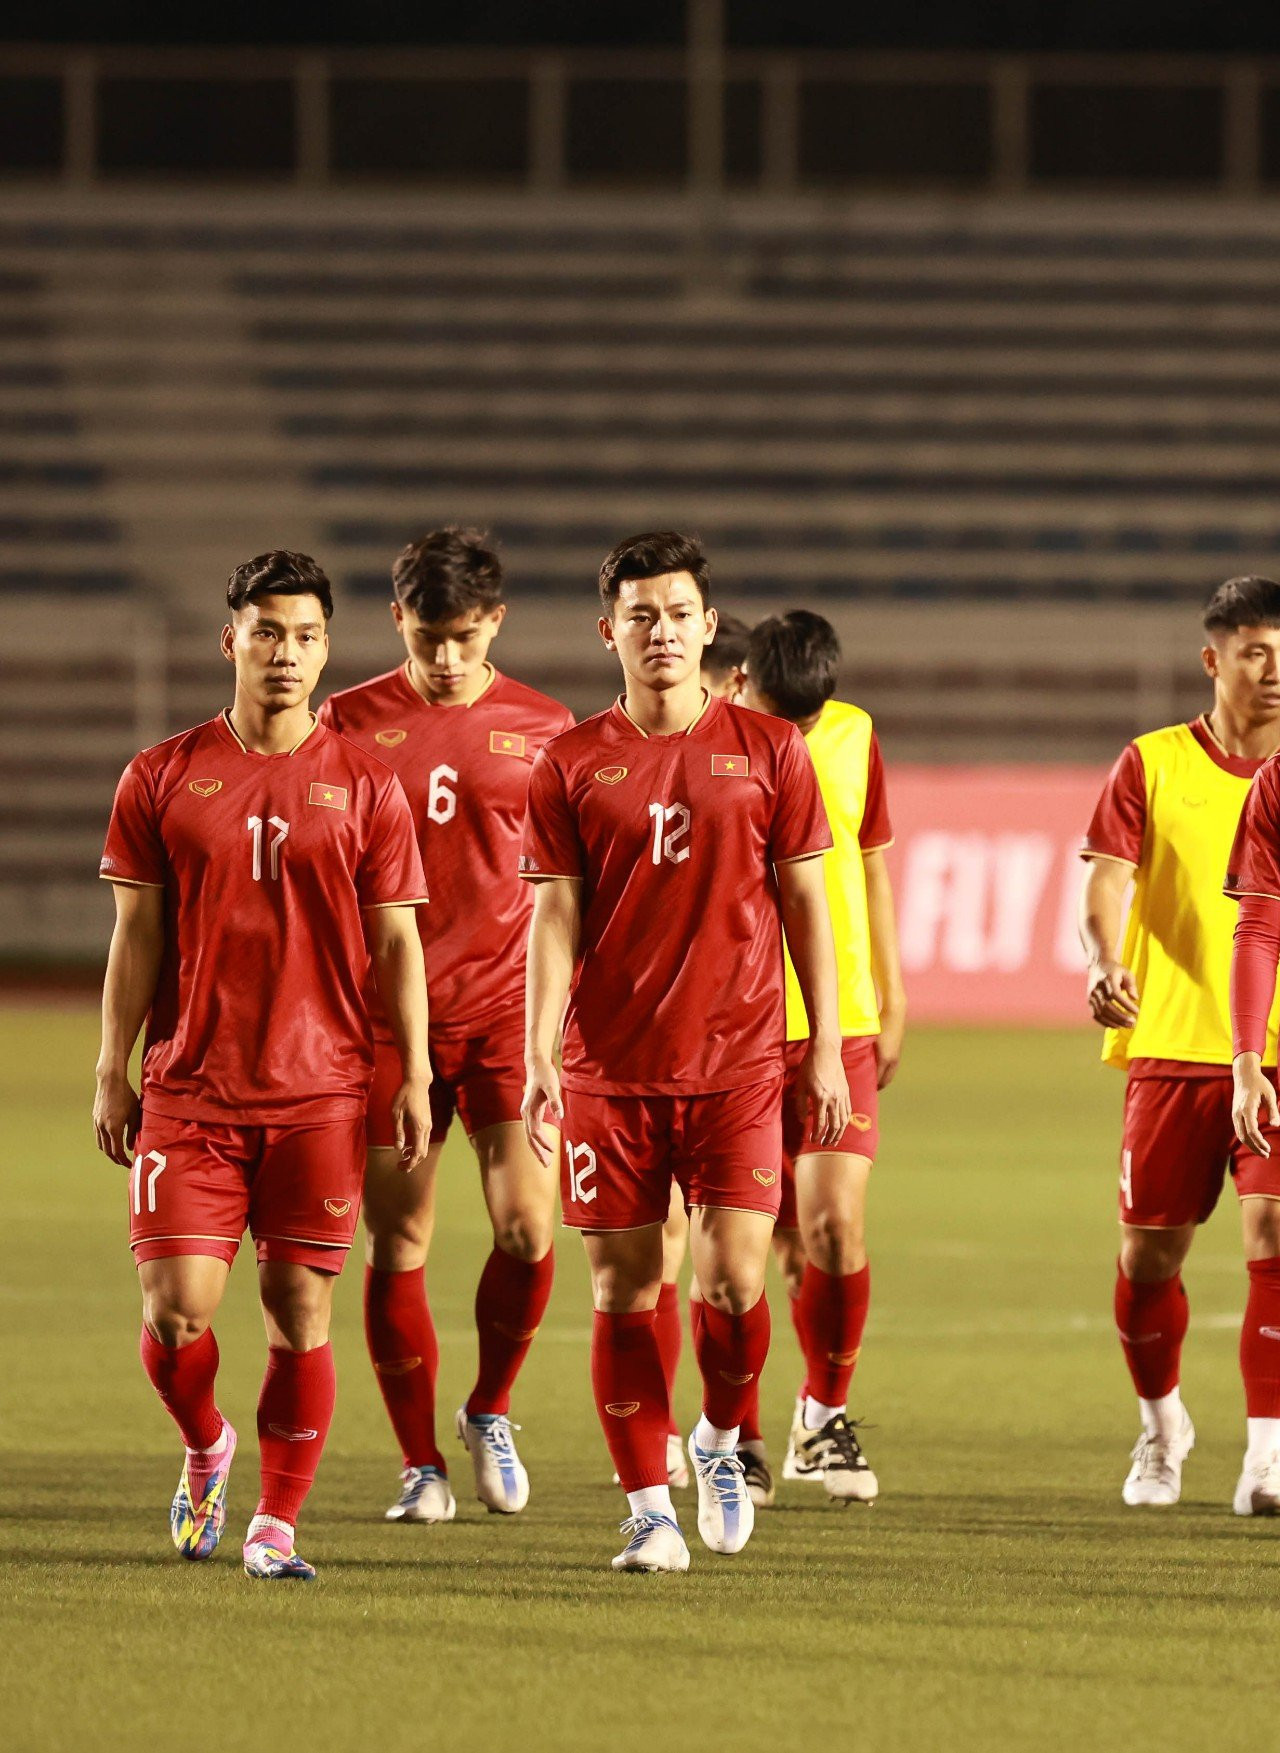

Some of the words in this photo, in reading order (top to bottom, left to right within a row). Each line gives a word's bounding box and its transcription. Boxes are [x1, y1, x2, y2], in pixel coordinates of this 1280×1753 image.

[428, 764, 458, 824] 6
[247, 815, 290, 882] 17
[649, 802, 690, 865] 12
[133, 1149, 167, 1215] 17
[565, 1139, 597, 1204] 12
